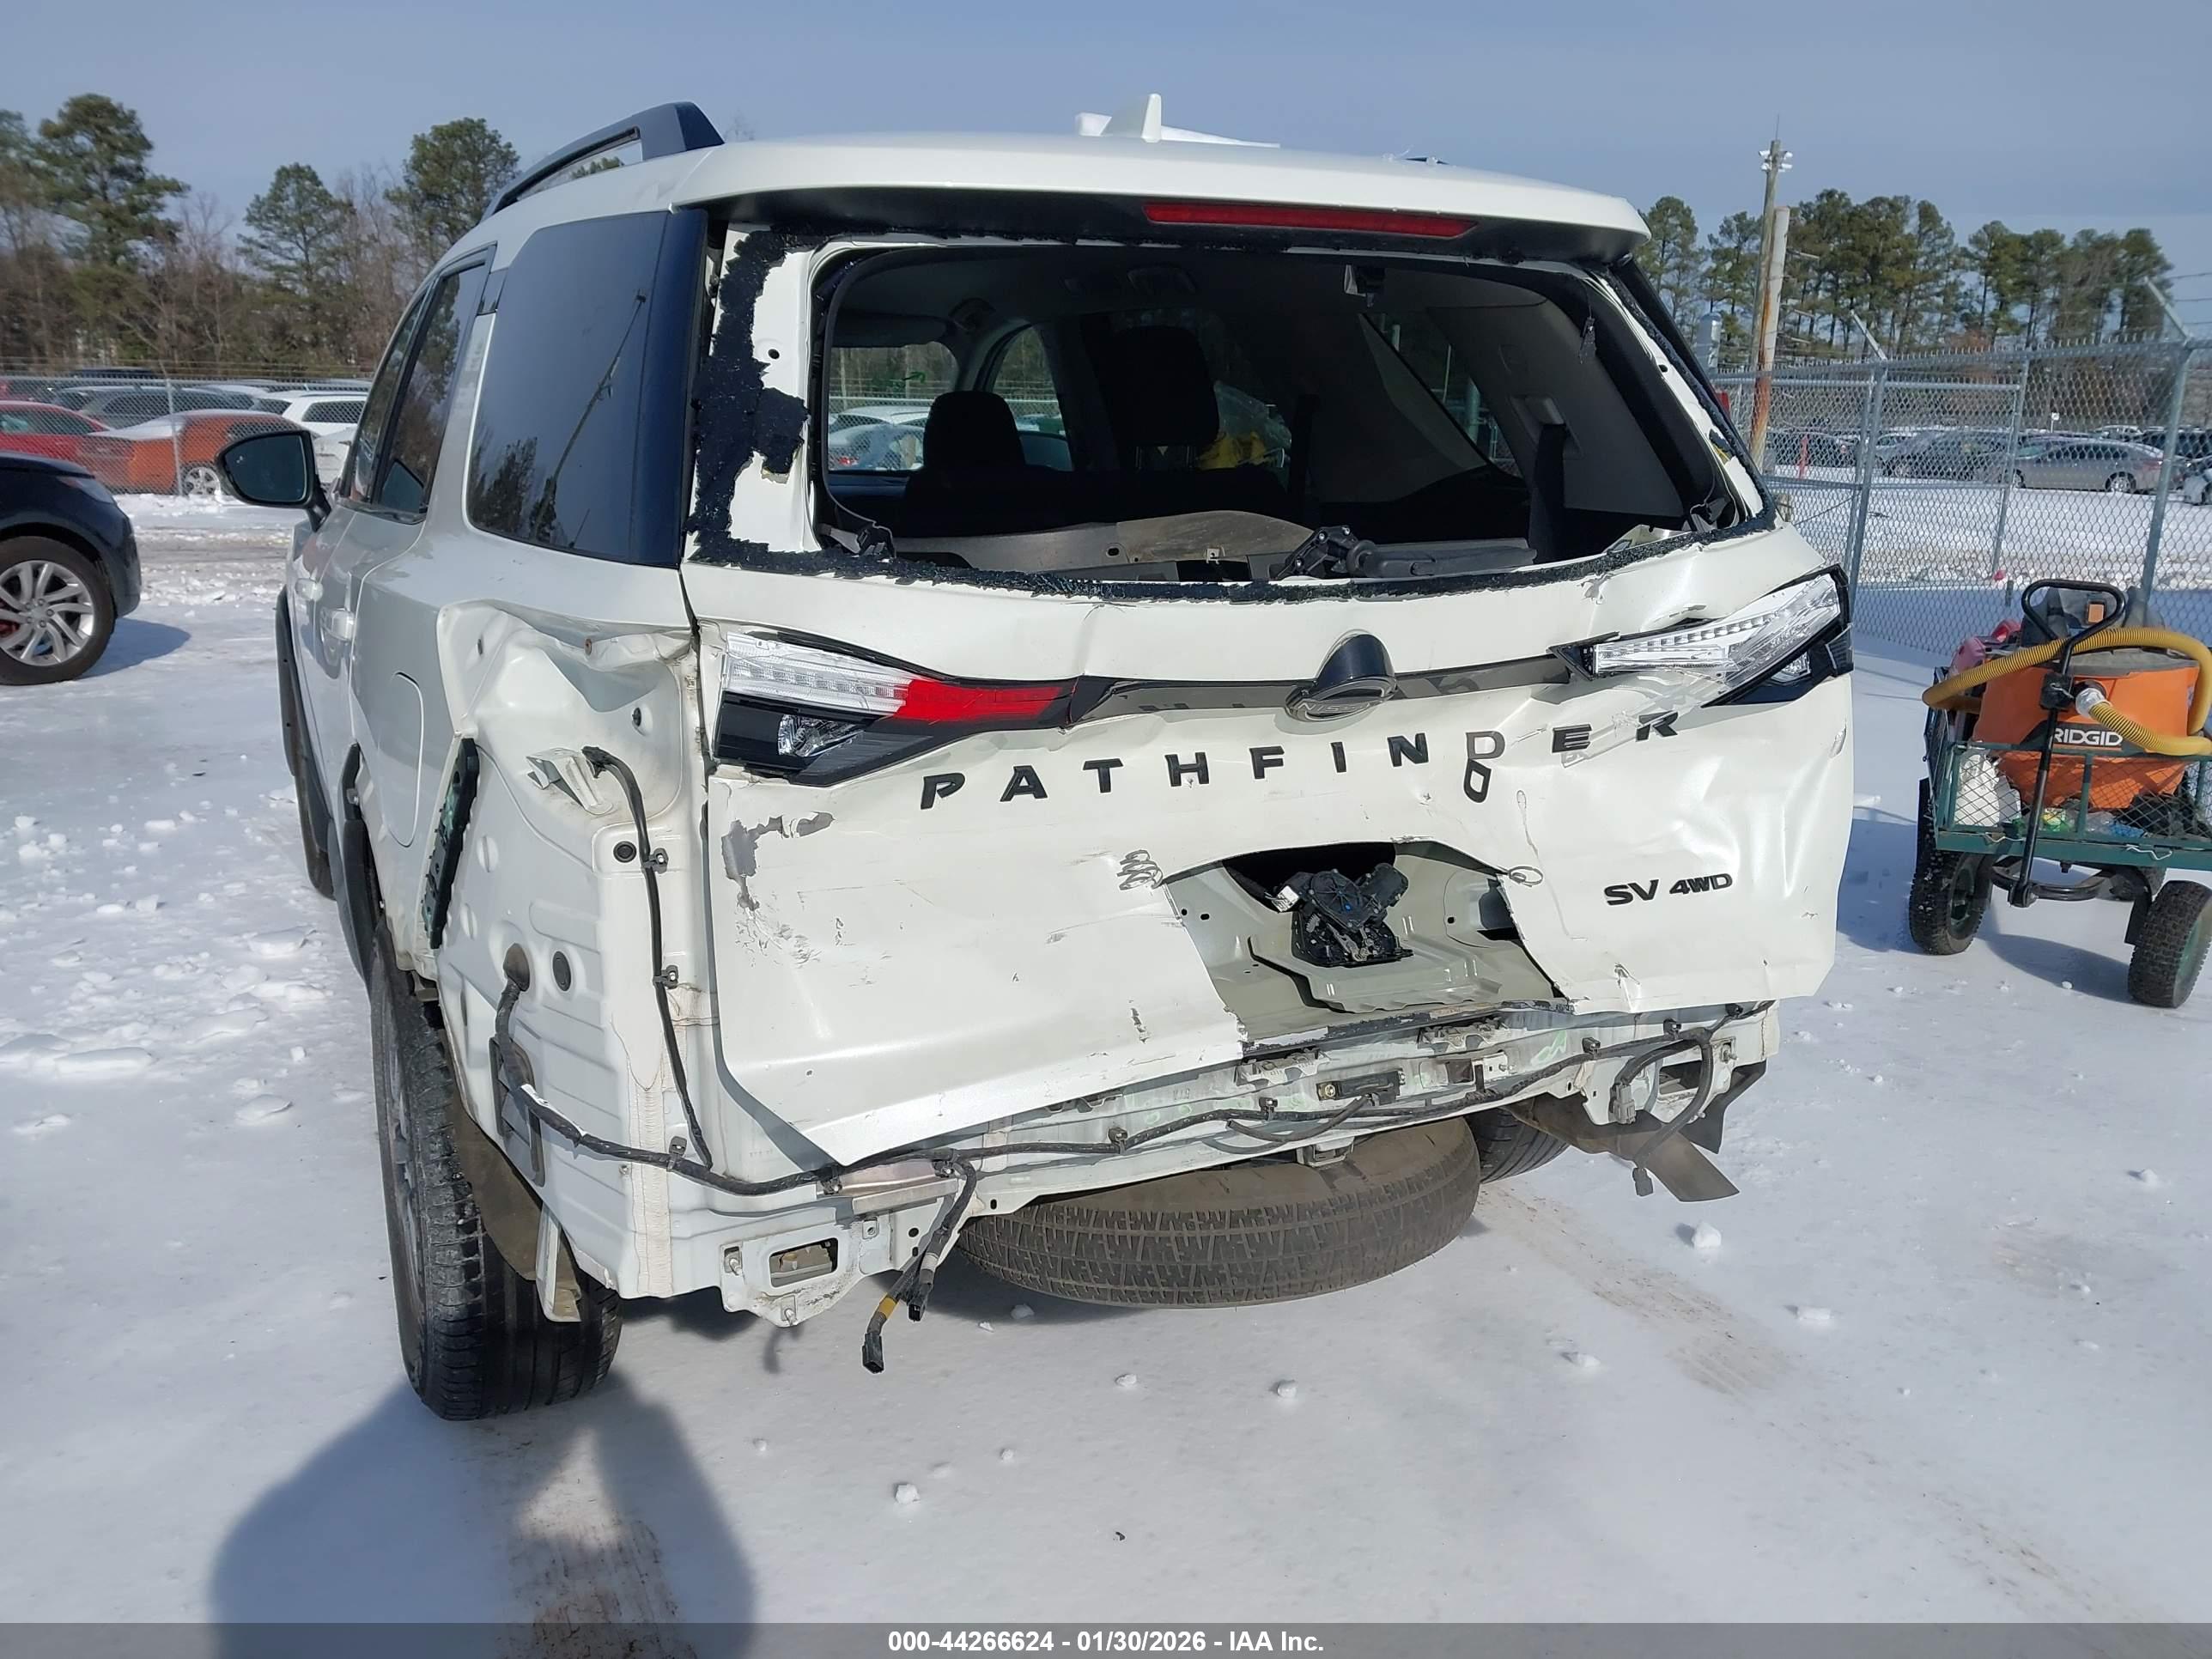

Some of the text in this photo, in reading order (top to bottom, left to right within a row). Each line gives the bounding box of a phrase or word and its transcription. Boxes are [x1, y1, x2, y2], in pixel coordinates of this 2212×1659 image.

[2053, 727, 2124, 746] RIDGID
[921, 711, 1680, 810] PATHFINDER
[1604, 873, 1733, 906] SV 4WD
